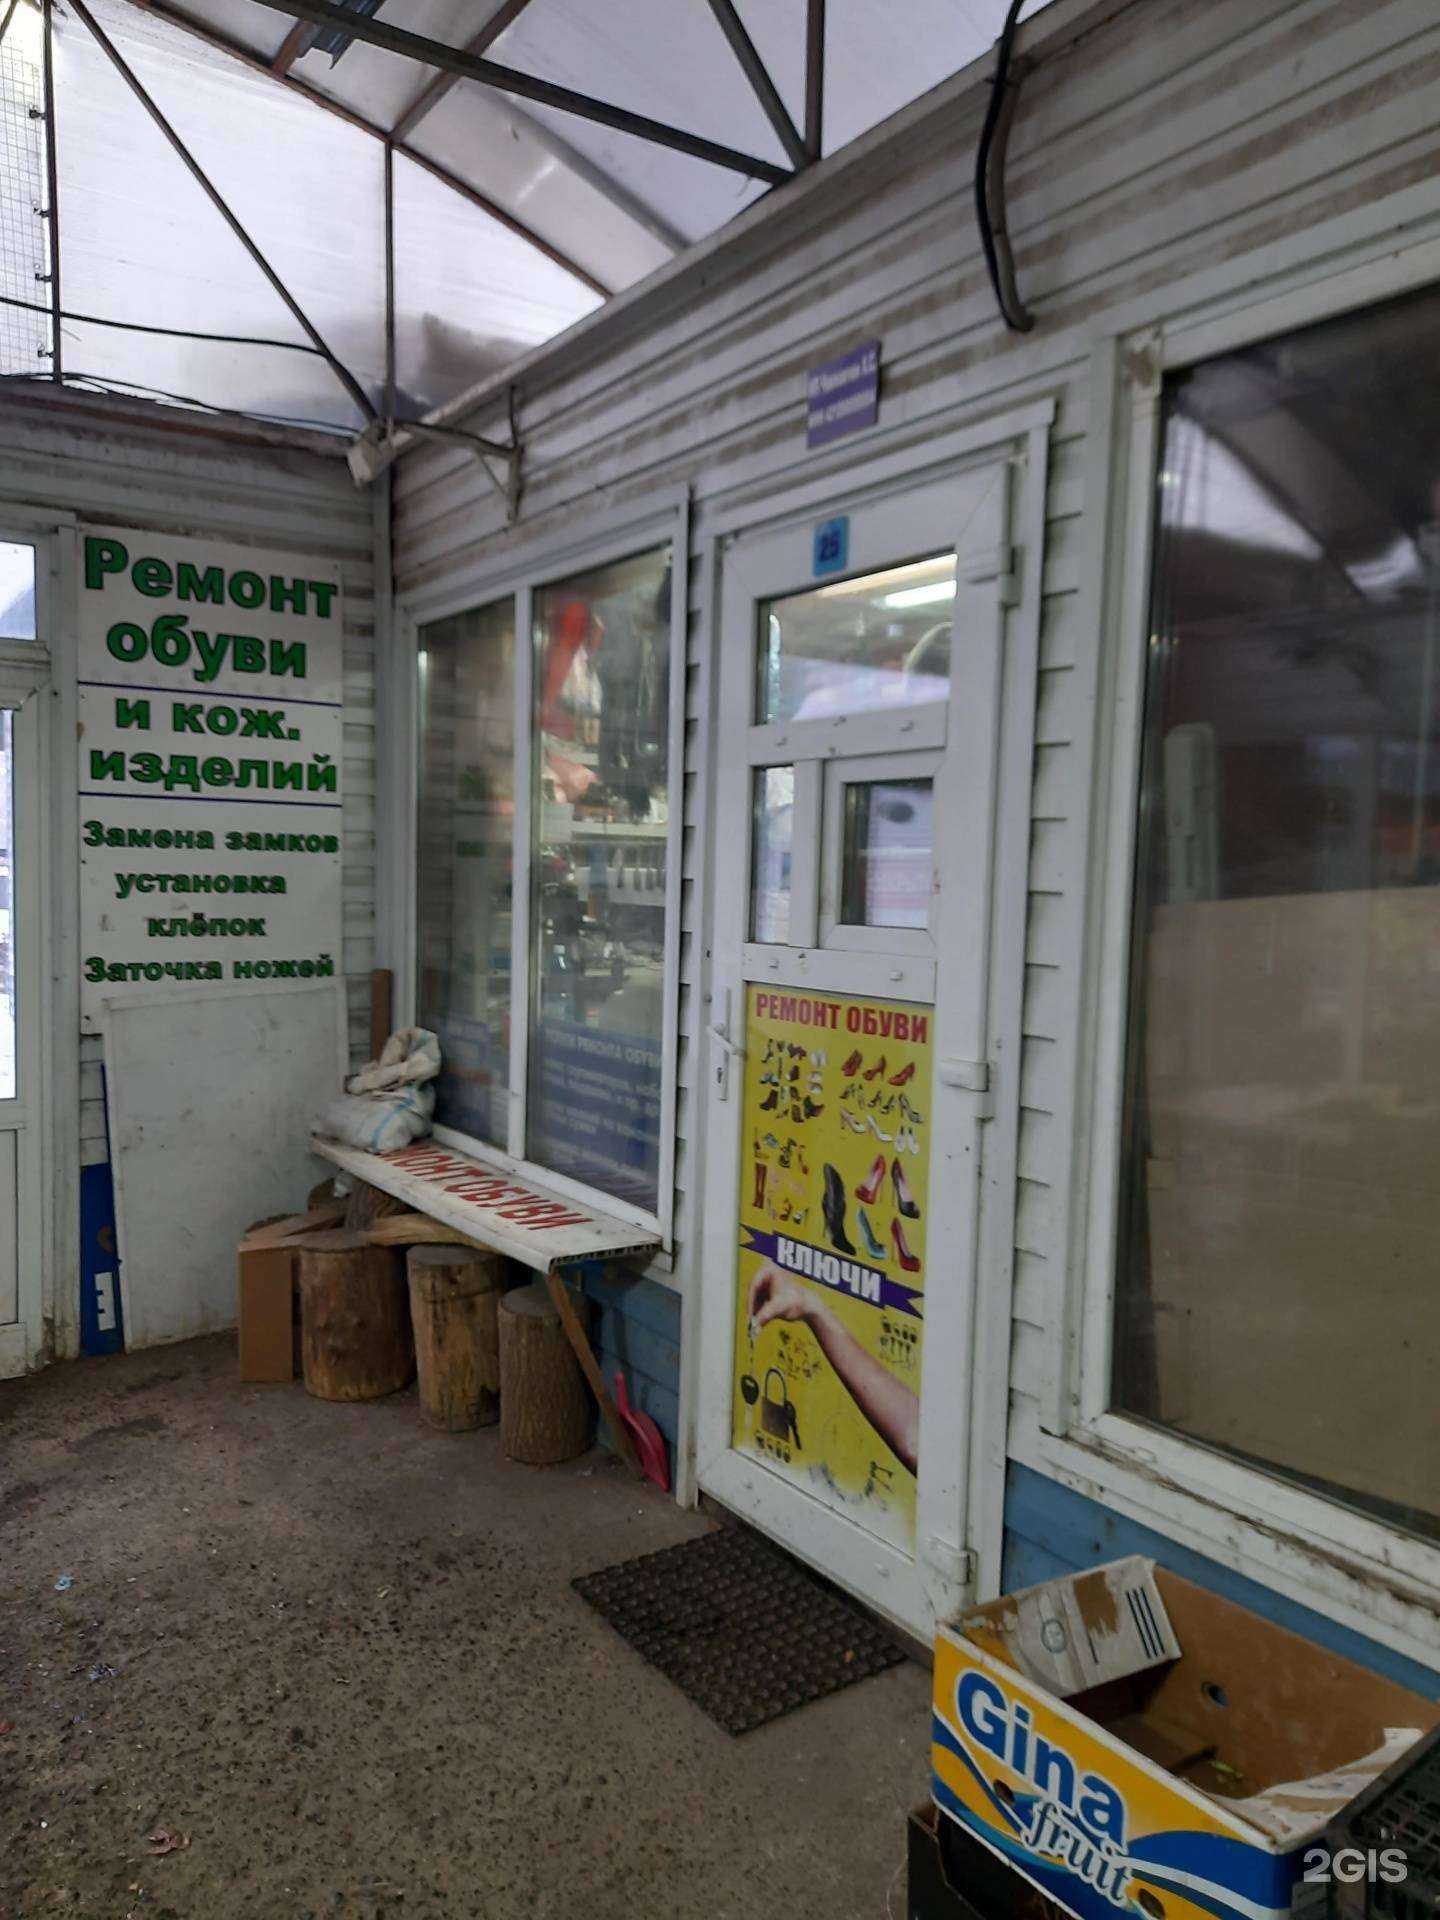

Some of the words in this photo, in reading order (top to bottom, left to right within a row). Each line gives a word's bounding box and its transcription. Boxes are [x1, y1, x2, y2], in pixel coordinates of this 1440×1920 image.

[83, 536, 338, 619] Ремонт
[106, 614, 307, 682] обуви
[115, 697, 151, 730] и
[172, 702, 301, 741] кож.
[89, 748, 337, 793] изделий
[83, 820, 215, 850] Замена
[225, 831, 339, 854] замков
[115, 871, 287, 899] установка
[148, 912, 266, 938] клёпок
[84, 956, 223, 984] Заточка
[233, 954, 335, 980] ножей
[755, 993, 842, 1030] РЕМОНТ
[846, 1005, 928, 1044] ОБУВИ
[443, 1180, 595, 1231] ОБУВИ
[776, 1236, 881, 1302] КЛЮЧИ
[957, 1670, 1127, 1852] Gina
[1024, 1801, 1133, 1902] fruit
